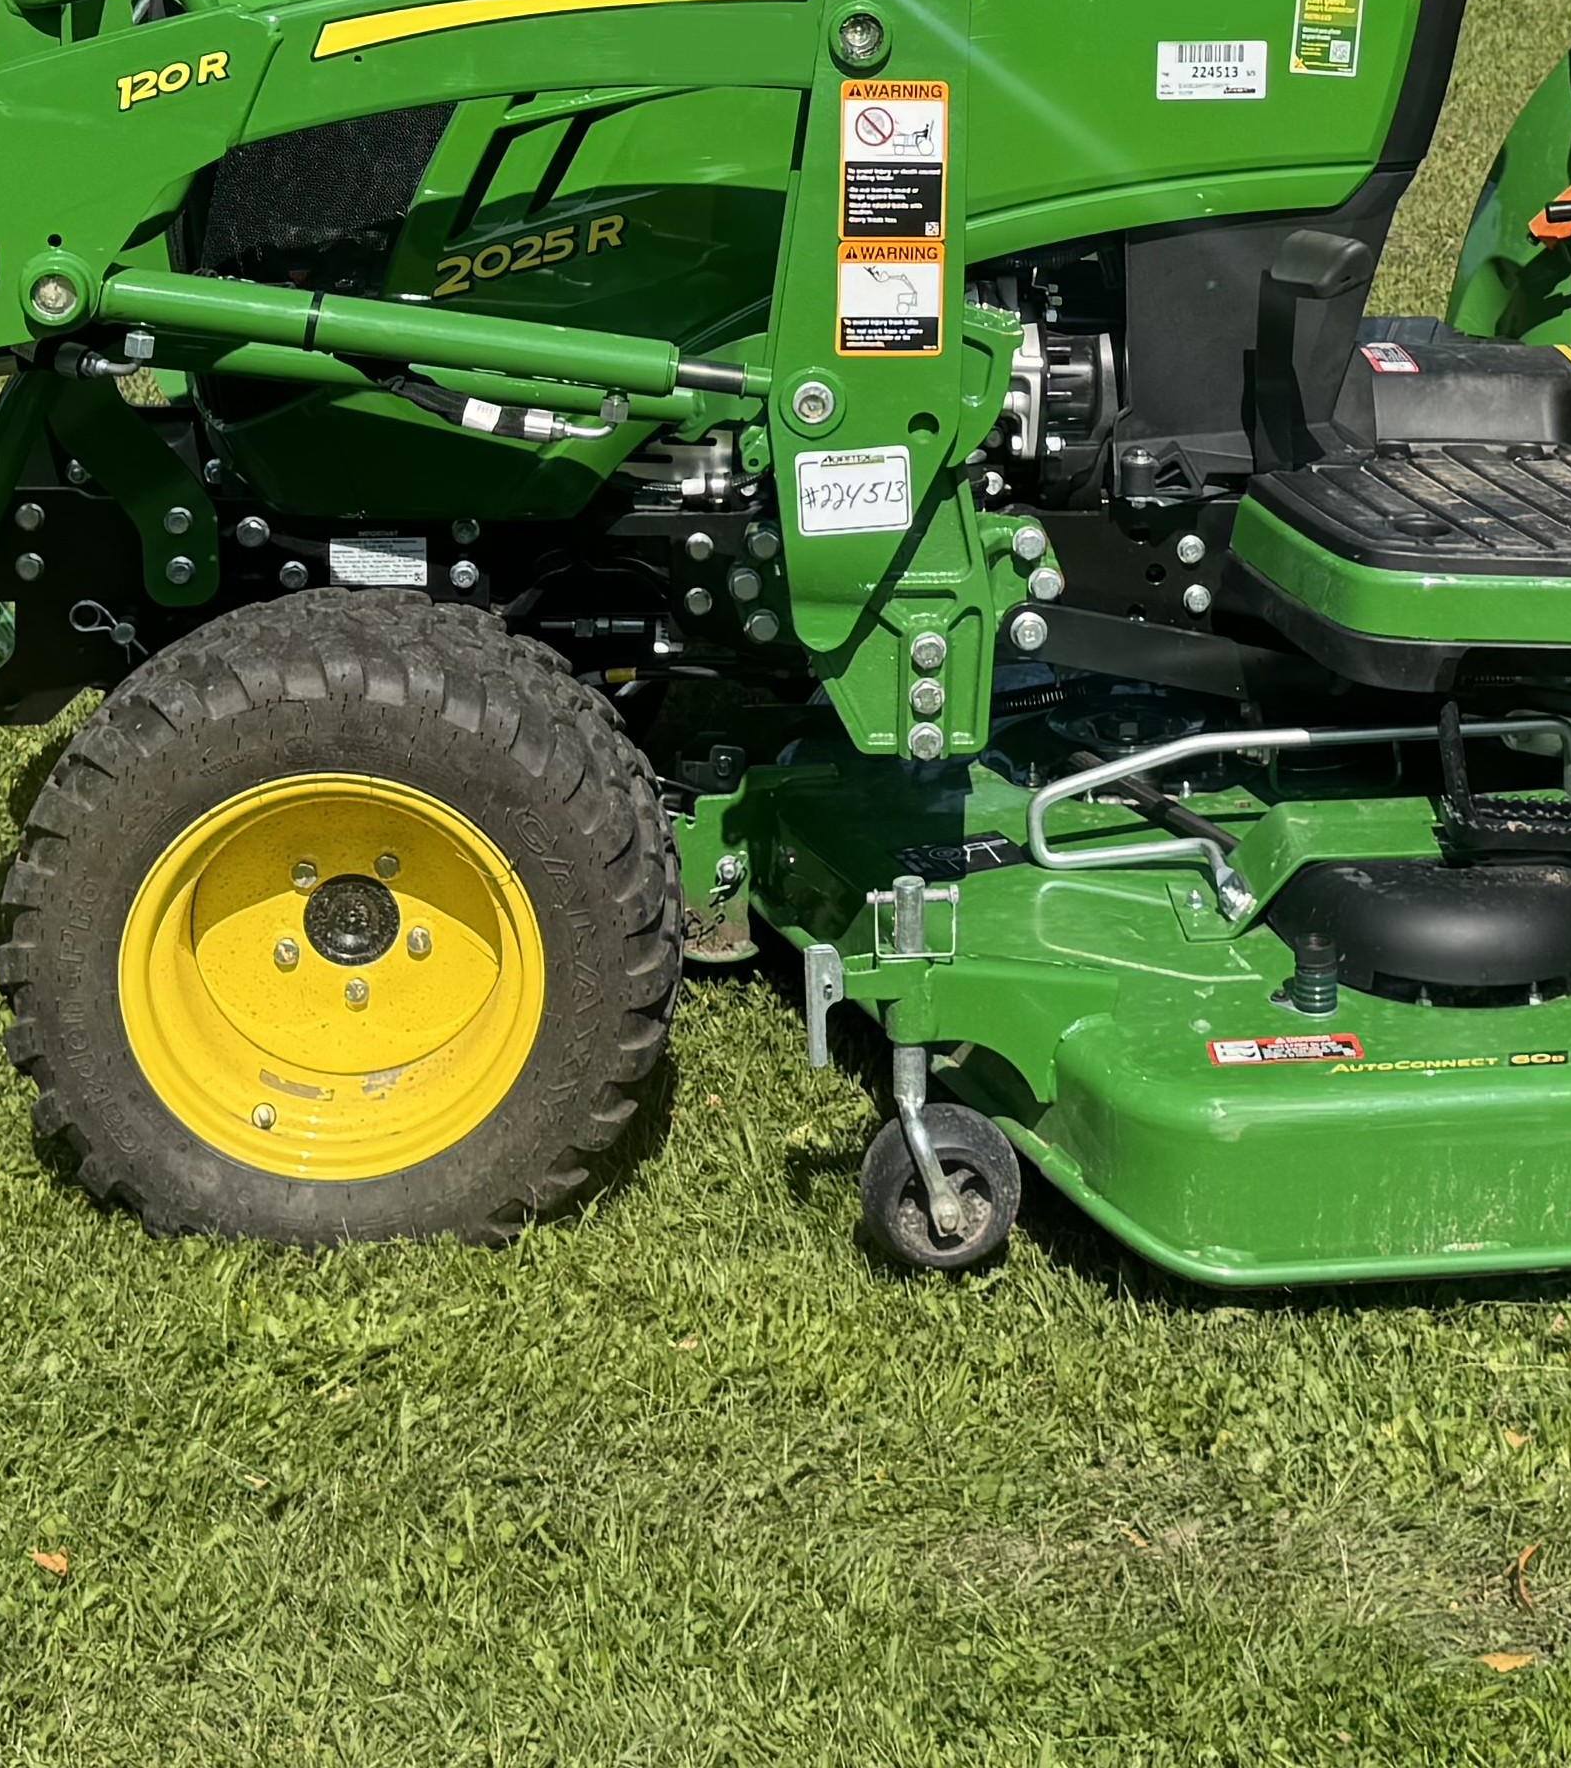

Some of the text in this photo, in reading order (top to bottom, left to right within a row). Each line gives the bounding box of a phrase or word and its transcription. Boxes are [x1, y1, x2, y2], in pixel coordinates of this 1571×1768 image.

[1191, 66, 1239, 78] 224513
[117, 51, 229, 111] 120 R
[863, 84, 943, 99] WARNING
[433, 214, 625, 298] 2025 R
[859, 246, 938, 260] WARNING
